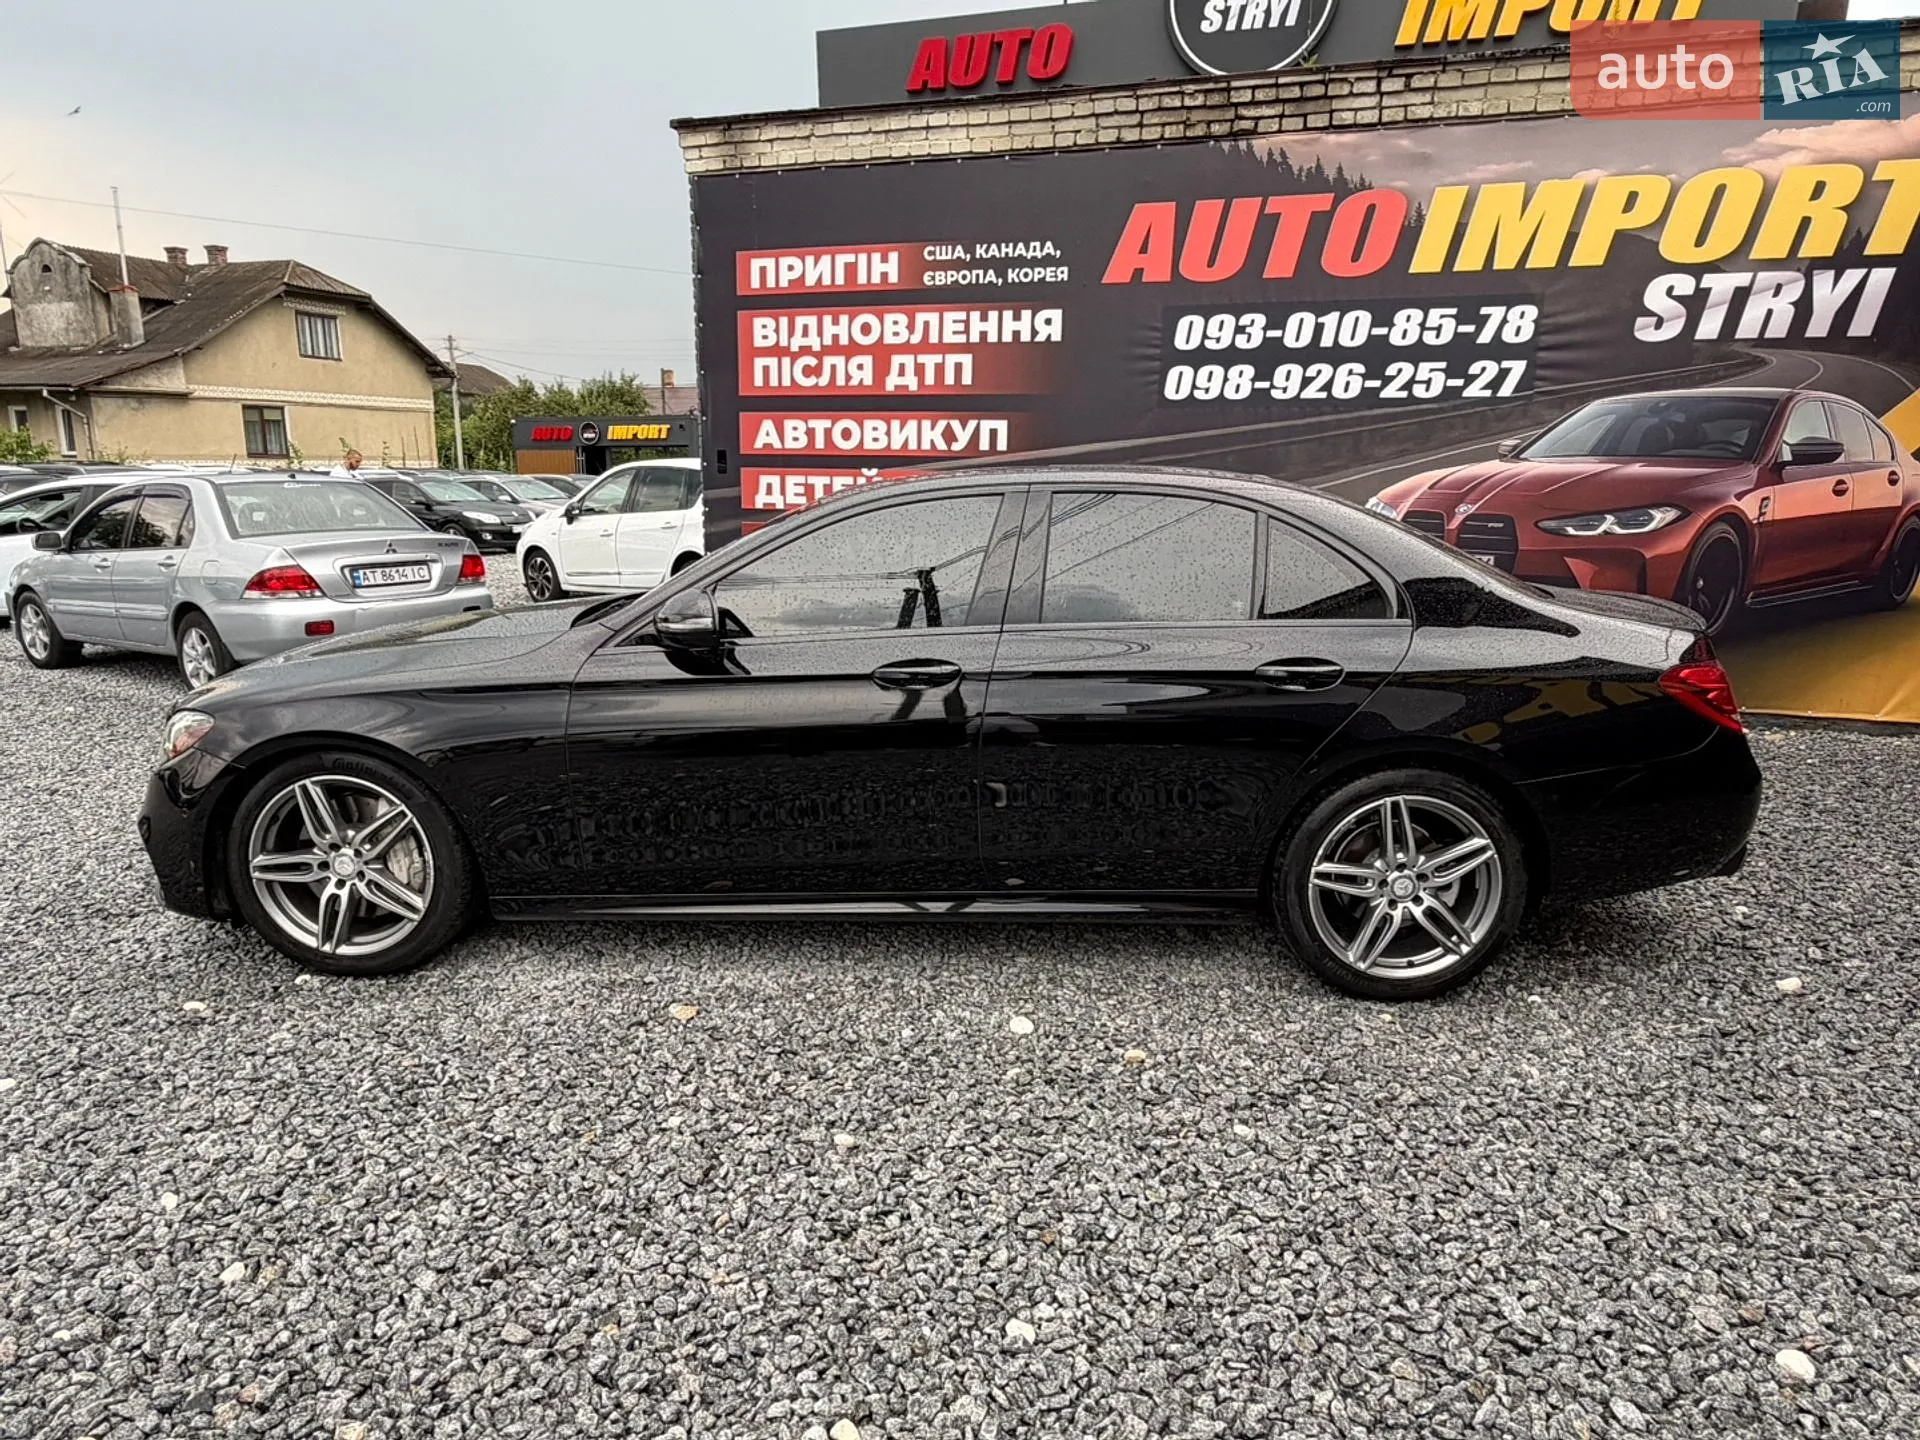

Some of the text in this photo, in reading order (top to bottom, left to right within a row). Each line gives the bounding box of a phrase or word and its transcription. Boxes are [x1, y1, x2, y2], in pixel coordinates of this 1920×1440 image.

[1200, 0, 1300, 33] STRYI
[905, 0, 1706, 92] AUTO IMP
[923, 241, 1062, 263] США, КАНАДА,
[1102, 188, 1408, 284] AUTO
[750, 251, 900, 290] ПРИГІН
[923, 266, 1069, 287] ЄВРОПА, КОРЕЯ
[1633, 267, 1897, 343] STRYI
[752, 308, 1064, 352] ВІДНОВЛЕННЯ
[1173, 304, 1539, 351] 093-010-85-78
[753, 353, 973, 392] ПІСЛЯ ДТП
[1163, 359, 1528, 401] 098-926-25-27
[531, 424, 671, 442] AUTO IMPORT
[753, 418, 1009, 452] АВТОВИКУП
[362, 566, 427, 584] AT 8614 IC
